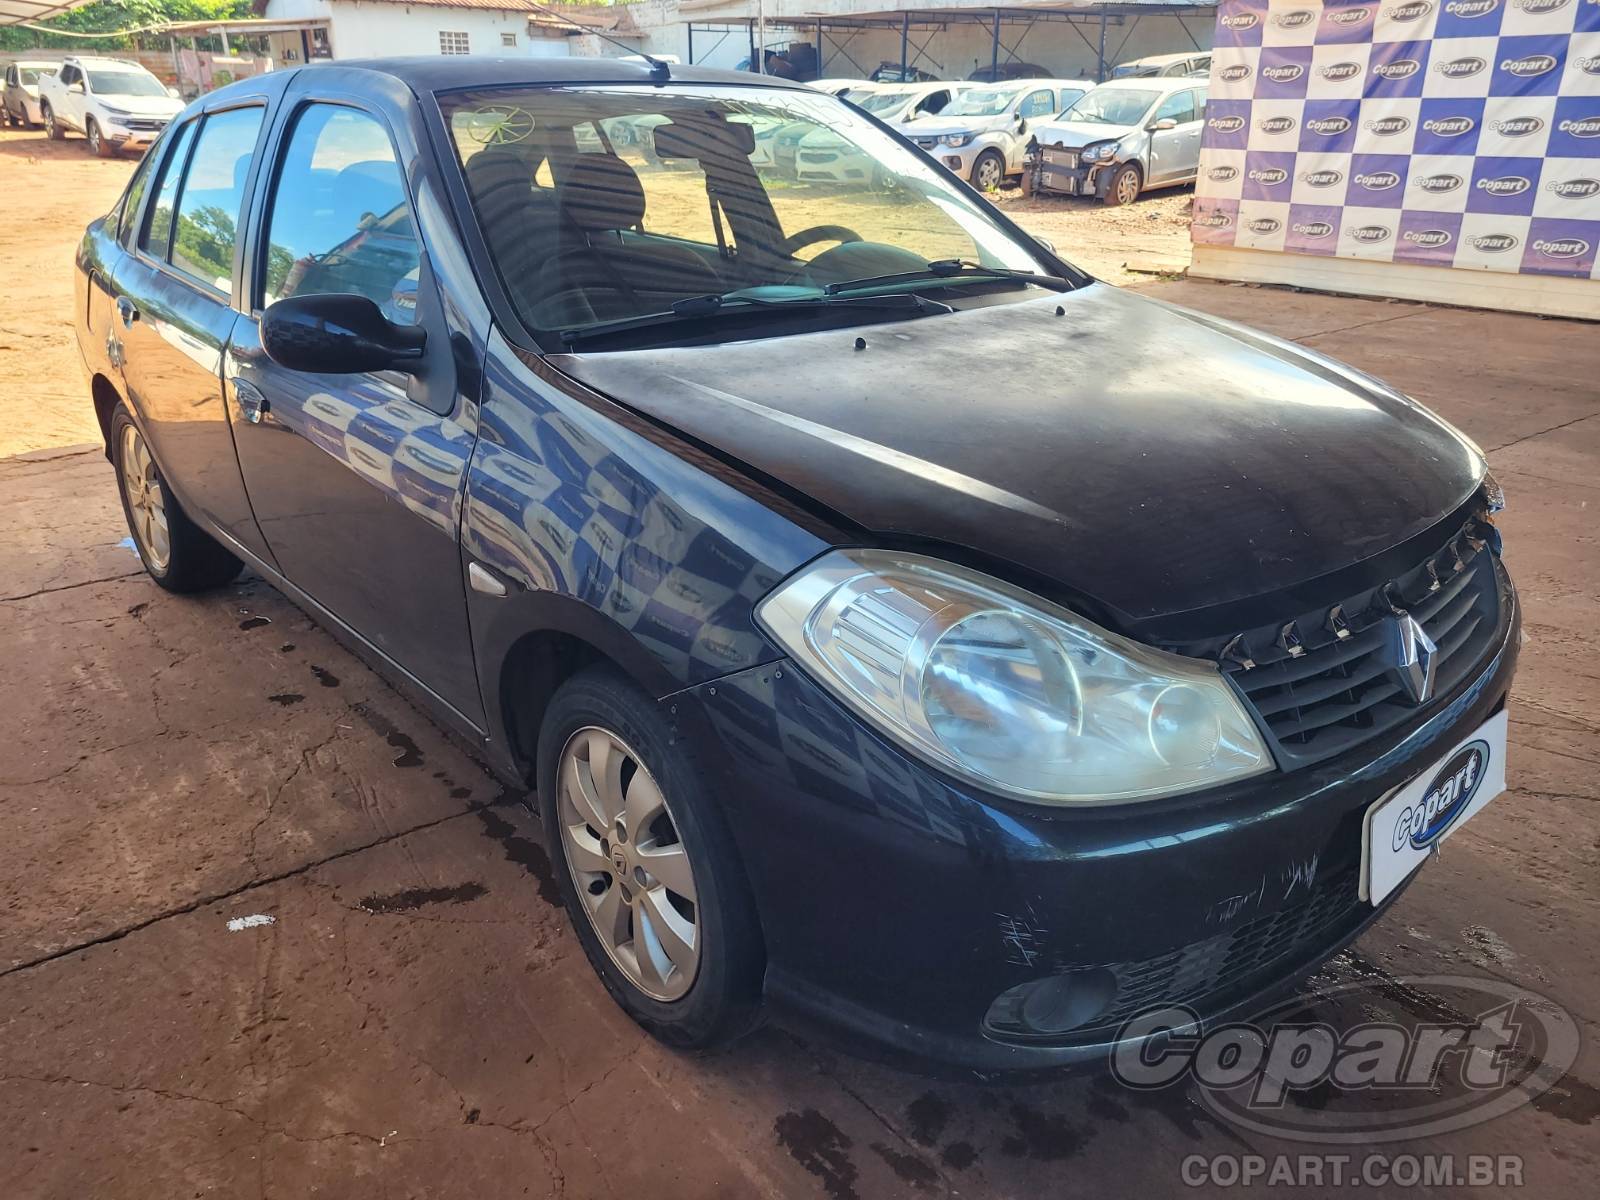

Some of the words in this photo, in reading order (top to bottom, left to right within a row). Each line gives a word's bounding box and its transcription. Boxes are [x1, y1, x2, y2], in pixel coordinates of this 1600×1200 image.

[1383, 2, 1424, 20] Copart
[1445, 0, 1491, 13] Copart
[1221, 13, 1254, 27] Copart
[1327, 9, 1365, 24] Copart
[1262, 66, 1298, 78] Copart
[1373, 60, 1416, 77] Copart
[1434, 60, 1478, 74] Copart
[1501, 58, 1549, 73] Copart
[1208, 118, 1240, 130] Copart
[1307, 119, 1346, 132] Copart
[1365, 119, 1405, 133] Copart
[1423, 119, 1469, 132] Copart
[1489, 119, 1535, 133] Copart
[1559, 119, 1600, 133] Copar
[1249, 170, 1283, 182] Copart
[1354, 173, 1395, 188] Copart
[1414, 176, 1458, 189] Copart
[1477, 178, 1525, 193] Copart
[1546, 181, 1595, 195] Copart
[1292, 223, 1327, 236] Copart
[1404, 231, 1445, 244] Copart
[1465, 235, 1511, 249] Copart
[1533, 240, 1581, 254] Copart
[1392, 748, 1478, 853] Copart
